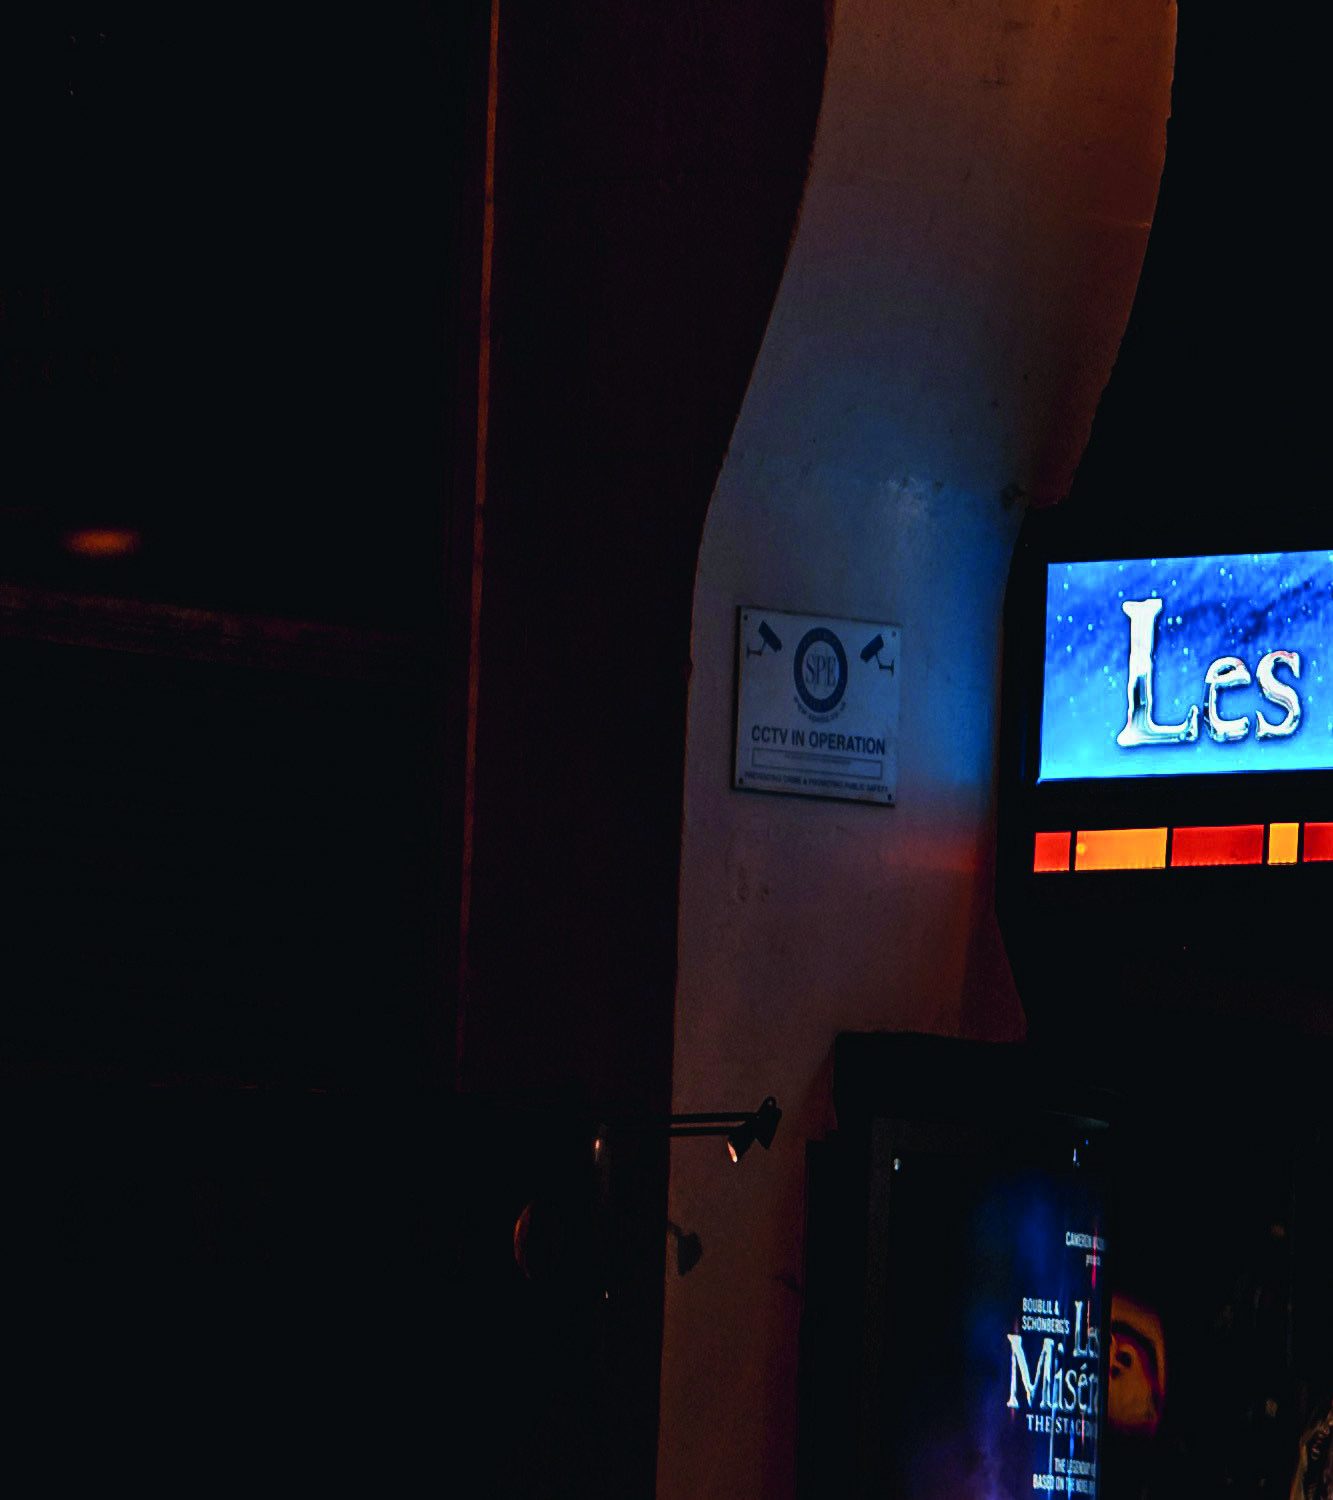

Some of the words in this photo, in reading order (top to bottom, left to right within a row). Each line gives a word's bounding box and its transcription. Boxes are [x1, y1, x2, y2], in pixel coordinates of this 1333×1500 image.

[1116, 598, 1302, 747] Les
[752, 725, 788, 745] CCTV
[792, 729, 804, 747] IN
[809, 731, 886, 755] OPERATION
[1026, 1414, 1052, 1433] THE
